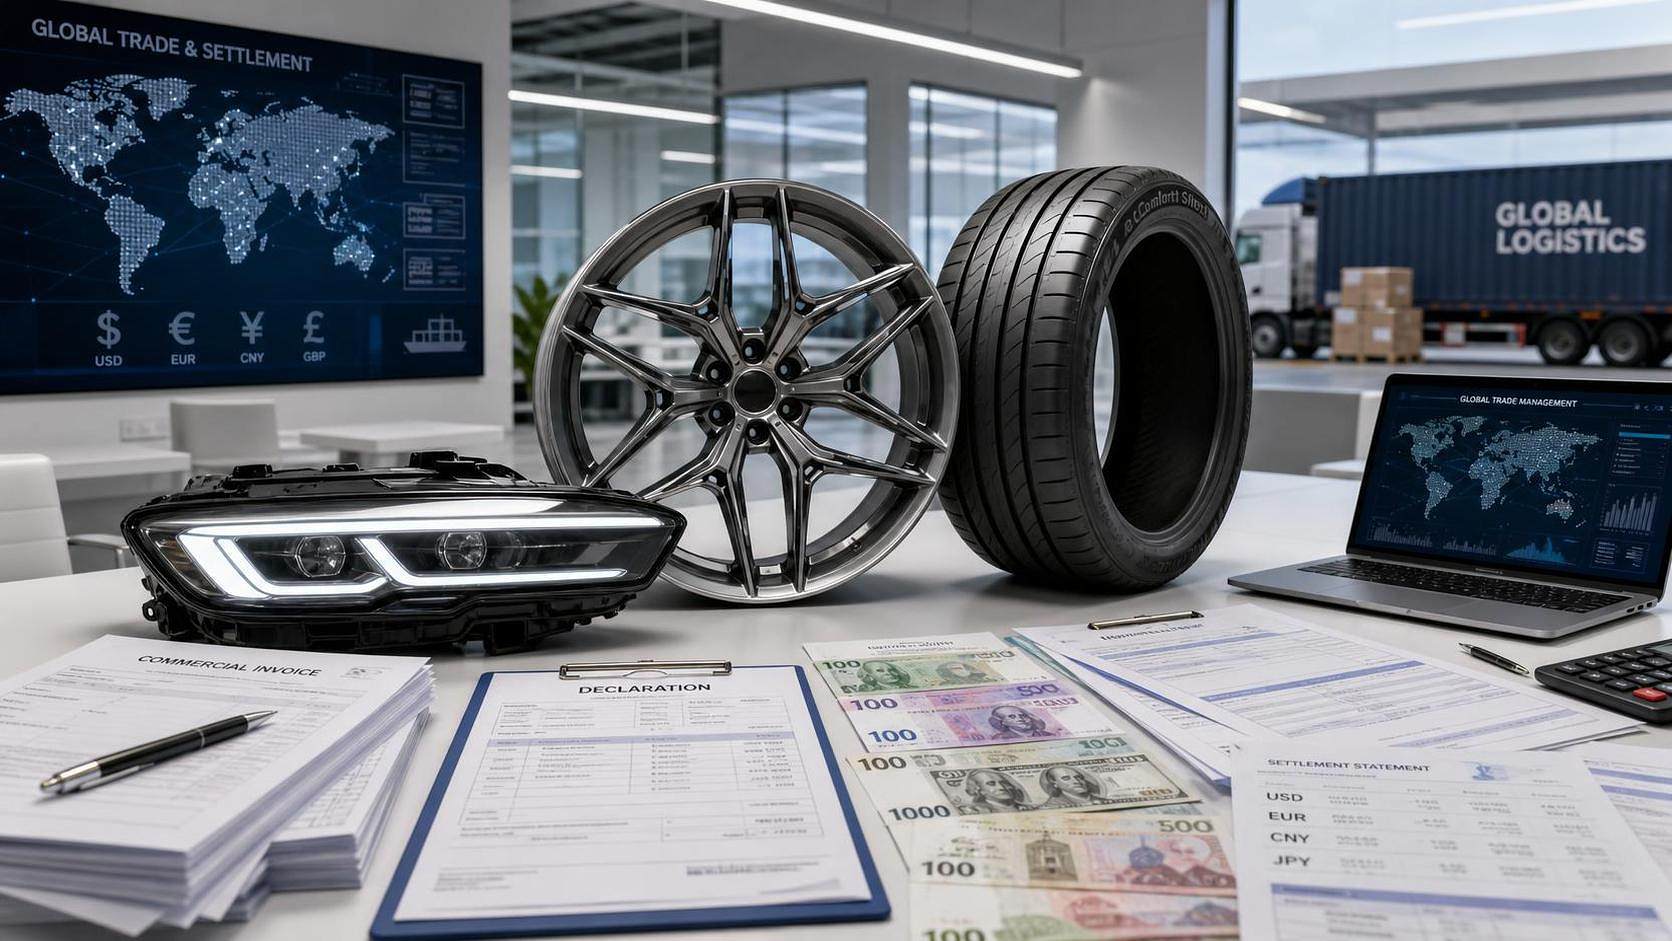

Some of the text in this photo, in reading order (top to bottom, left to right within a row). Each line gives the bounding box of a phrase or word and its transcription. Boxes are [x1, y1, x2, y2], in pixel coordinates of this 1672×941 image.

[32, 18, 313, 73] GLOBAL TRADE & SETTLEMENT
[1495, 200, 1611, 228] GLOBAL
[1496, 226, 1647, 255] LOGISTICS
[97, 309, 121, 349] $
[168, 311, 196, 346] €
[240, 311, 265, 345] ¥
[303, 310, 325, 344] £
[94, 354, 123, 367] USD
[171, 353, 197, 365] EUR
[240, 352, 265, 363] CNY
[303, 350, 326, 362] GBP
[1460, 395, 1578, 407] GLOBAL TRADE MANAGEMENT
[138, 655, 322, 678] COMMERCIAL INVOICE
[822, 660, 861, 670] 100
[578, 683, 711, 695] DECLARATION
[850, 698, 898, 711] 100
[868, 729, 918, 743] 100
[858, 756, 907, 771] 100
[1267, 758, 1430, 773] SETTLEMENT STATEMENT
[1266, 792, 1303, 802] USD
[888, 804, 951, 821] 1000
[1268, 811, 1307, 822] EUR
[1157, 819, 1214, 833] 500
[1270, 832, 1310, 844] CNY
[1272, 855, 1311, 867] JPY
[920, 861, 975, 877] 100
[922, 927, 984, 941] 100
